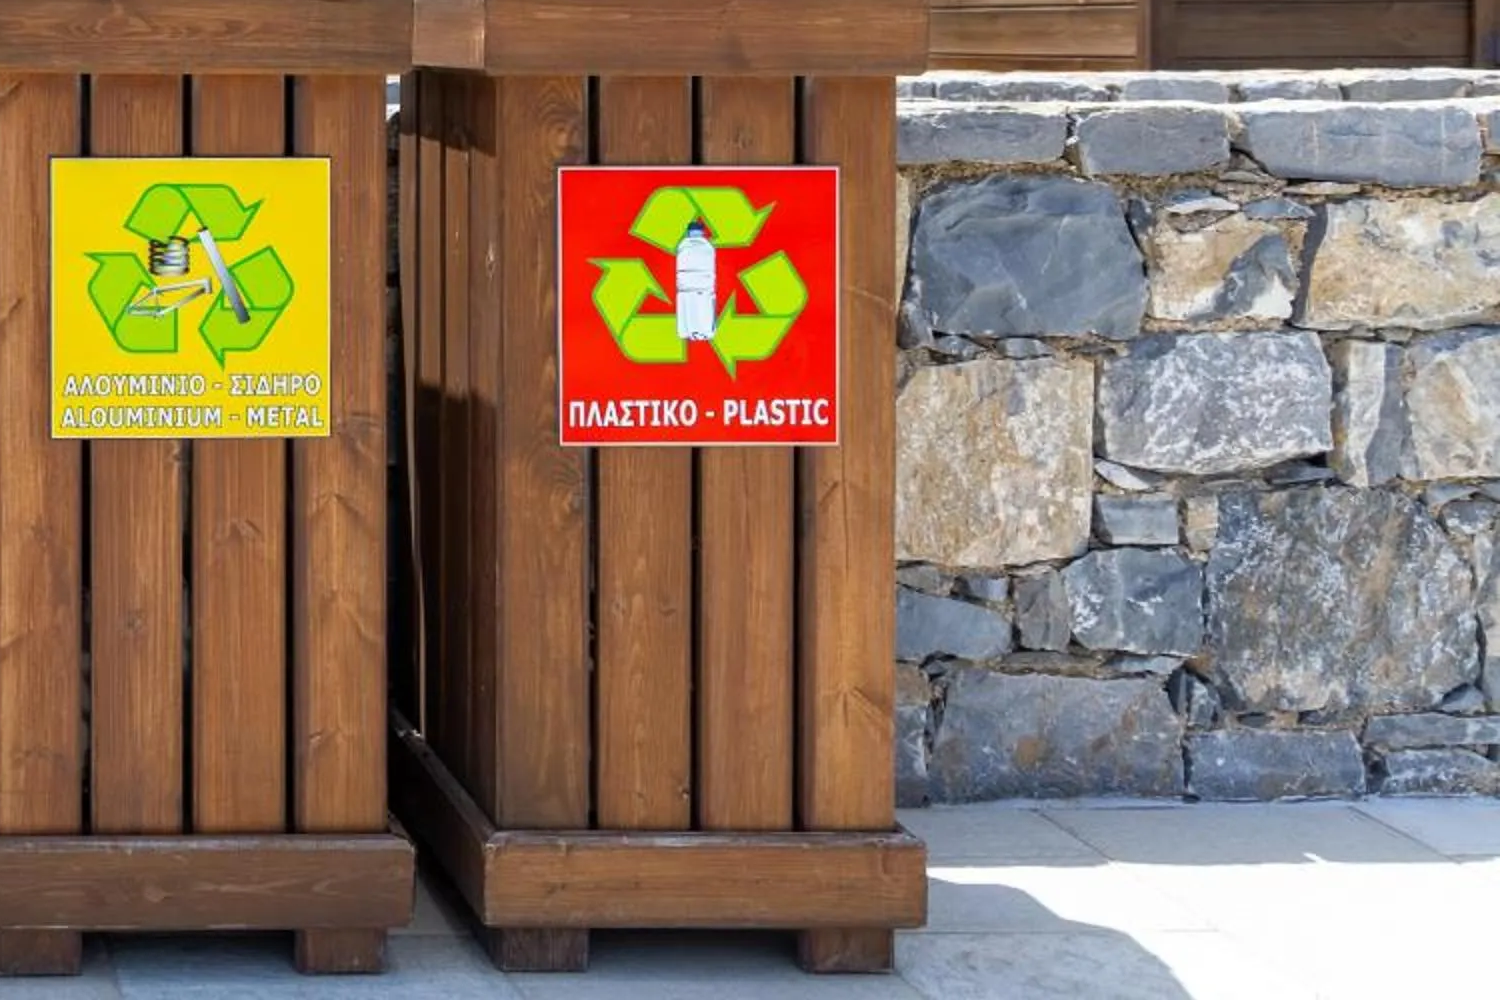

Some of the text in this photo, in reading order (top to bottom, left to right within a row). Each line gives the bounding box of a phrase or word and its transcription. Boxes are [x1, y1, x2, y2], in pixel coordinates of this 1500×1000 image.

[63, 373, 206, 396] ΑΛΟΥΜΙΝΙΟ
[229, 373, 322, 396] ΣΙΔΗΡΟ
[61, 406, 222, 428] ALOUMINIUM
[246, 405, 324, 428] METAL
[569, 399, 697, 427] ΠΛΑΣΤΙΚΟ
[723, 399, 829, 427] PLASTIC
